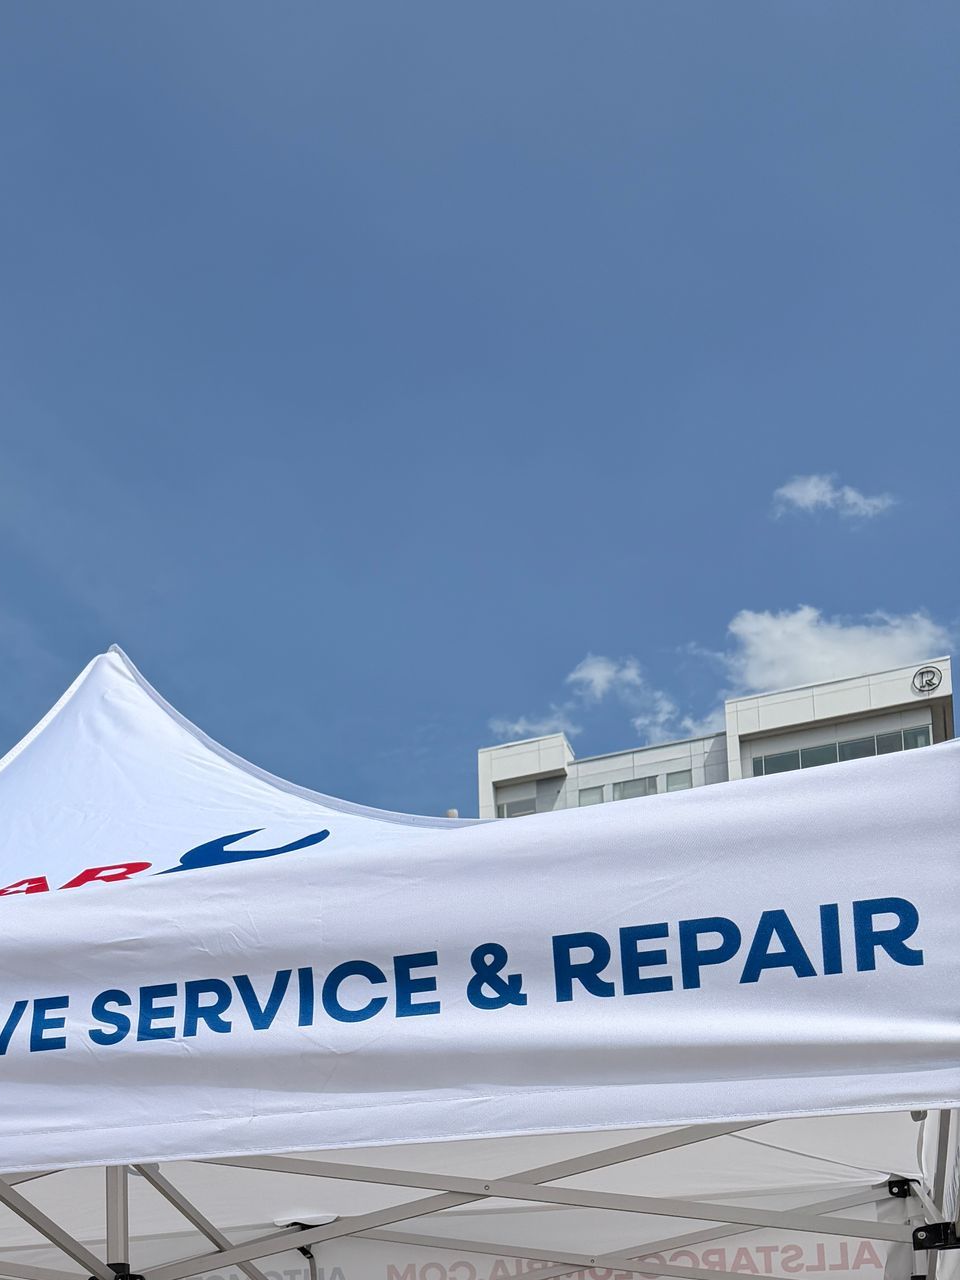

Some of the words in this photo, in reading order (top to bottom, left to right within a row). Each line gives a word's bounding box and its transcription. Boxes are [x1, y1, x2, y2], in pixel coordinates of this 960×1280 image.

[88, 951, 441, 1046] SERVICE
[466, 943, 528, 1010] &
[551, 897, 924, 1003] REPAIR
